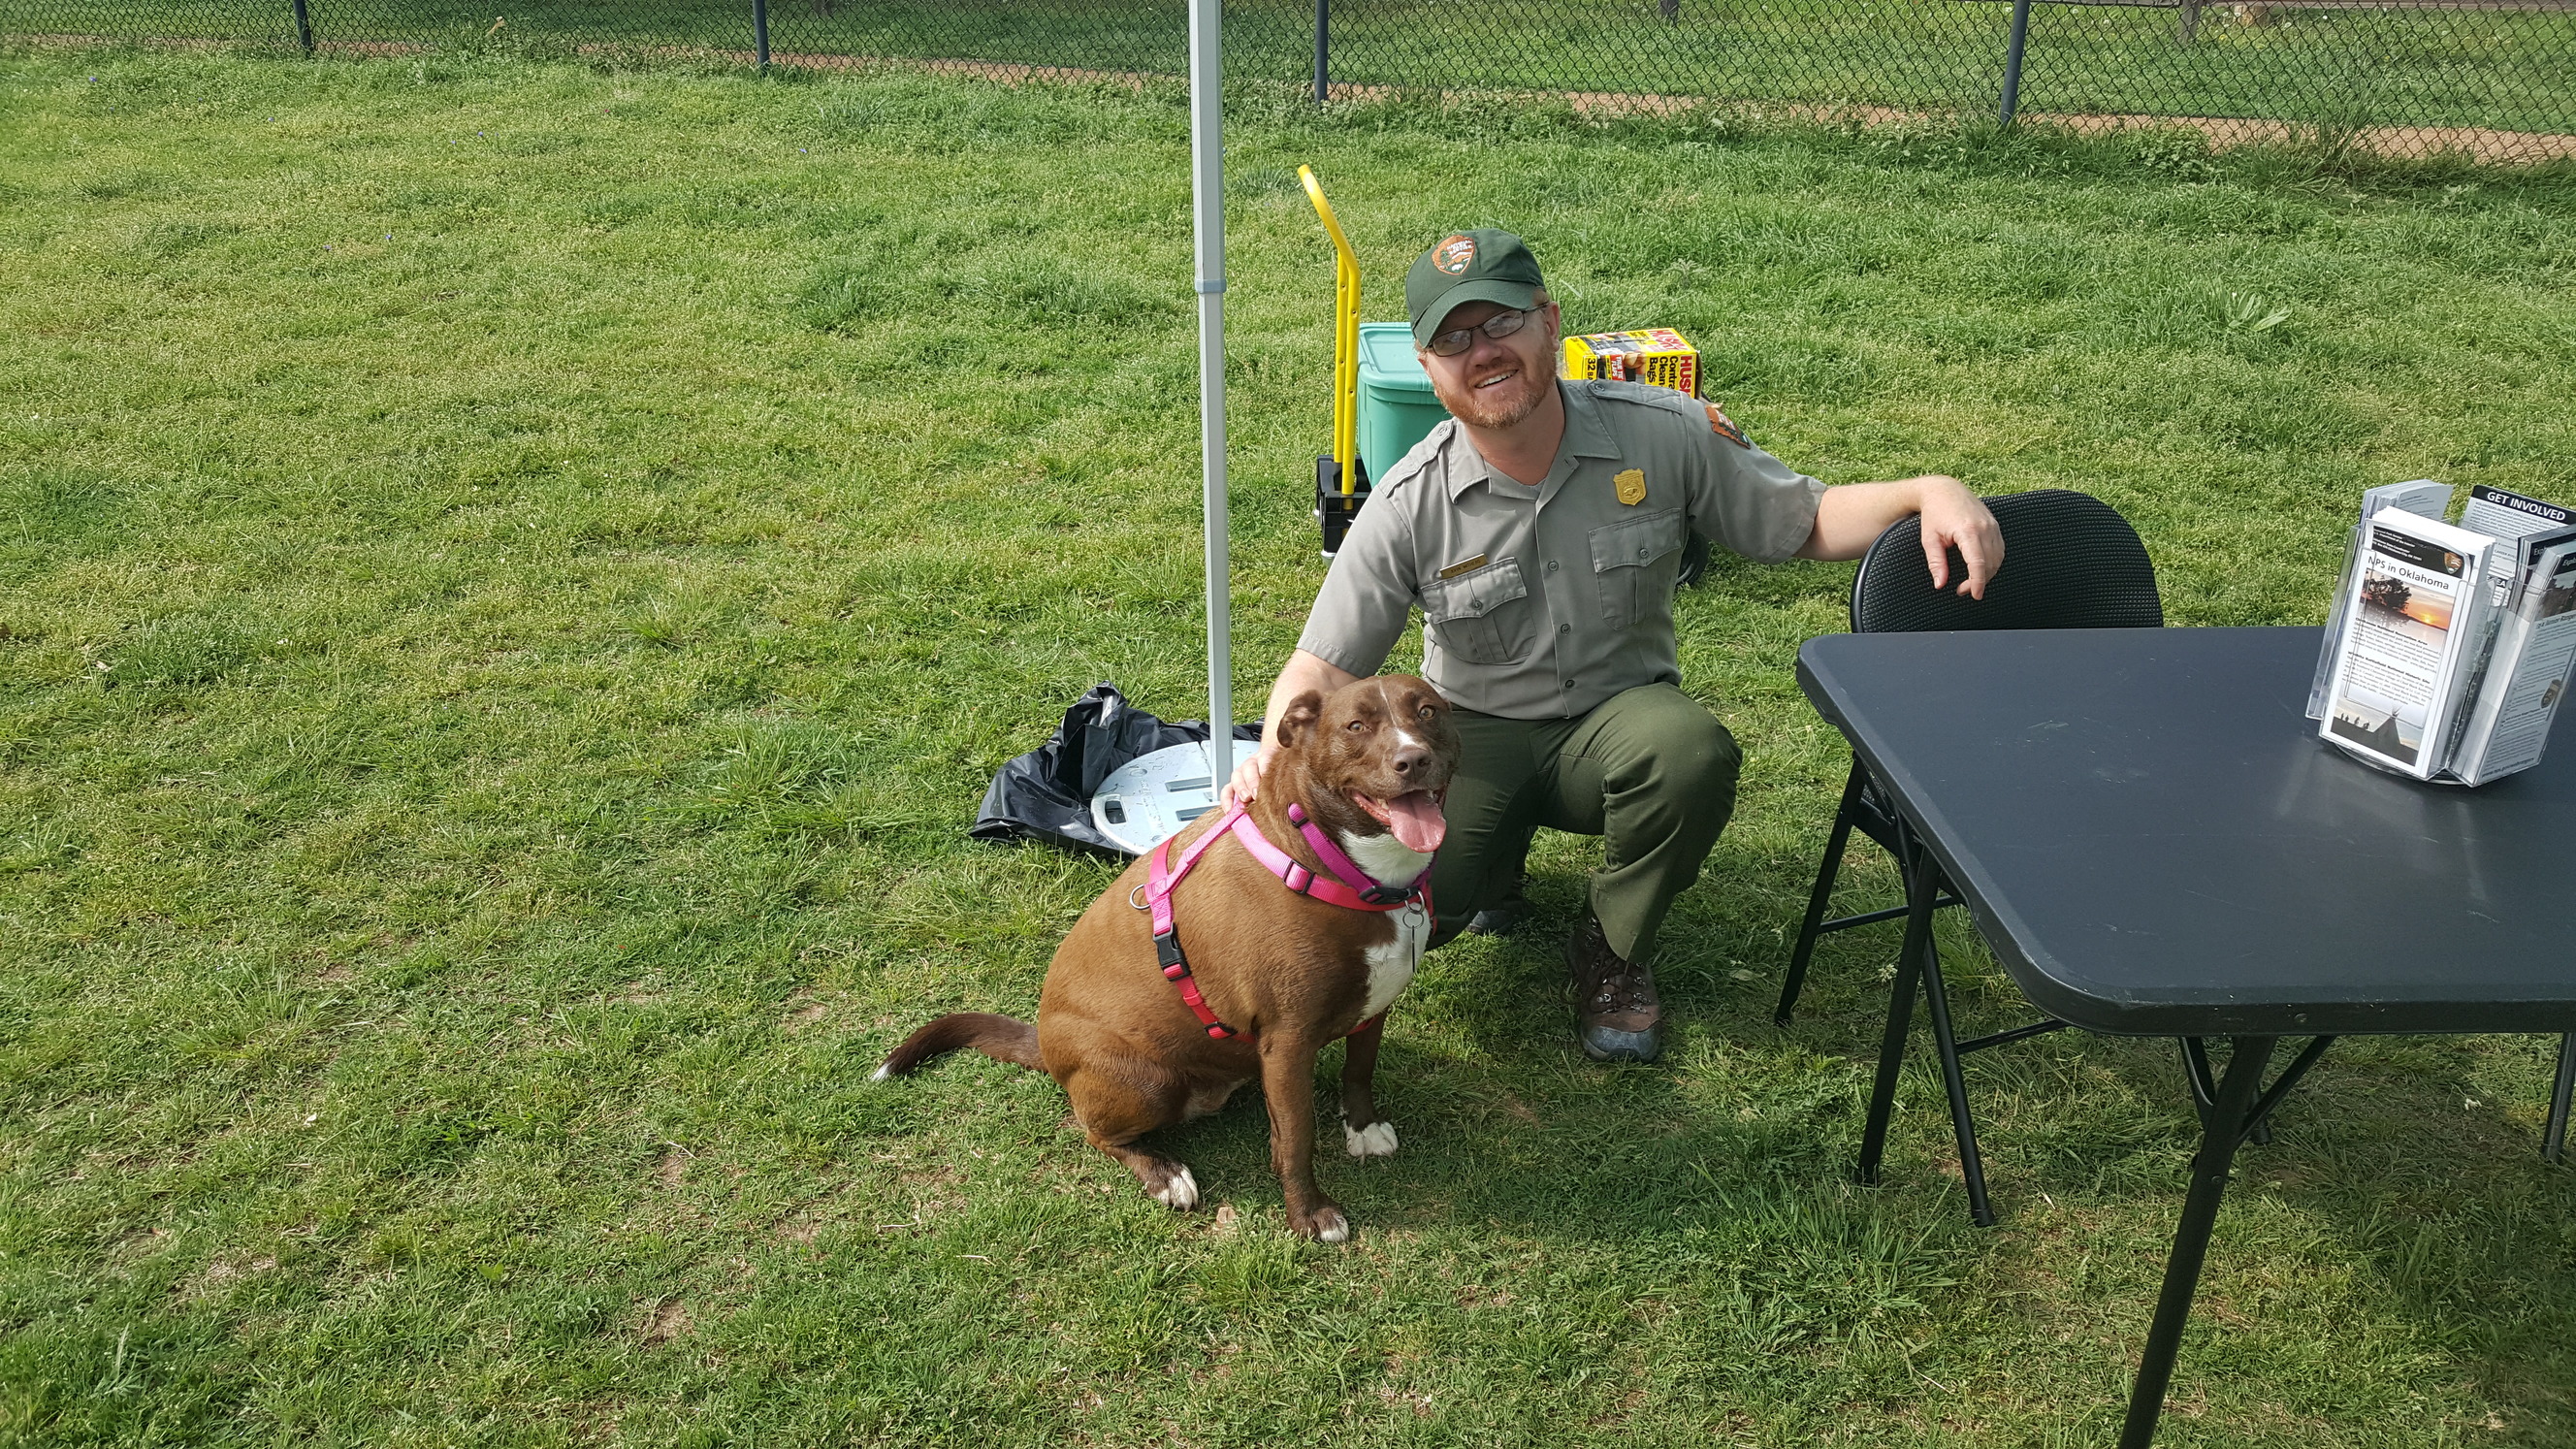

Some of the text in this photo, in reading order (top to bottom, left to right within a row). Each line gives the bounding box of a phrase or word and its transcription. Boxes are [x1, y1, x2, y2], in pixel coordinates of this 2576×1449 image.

[1588, 358, 1595, 370] 32
[1647, 357, 1658, 383] Bags
[1658, 356, 1668, 387] Clean
[2487, 491, 2566, 521] GET INVOLVED
[2367, 556, 2449, 590] NPS in Oklahoma
